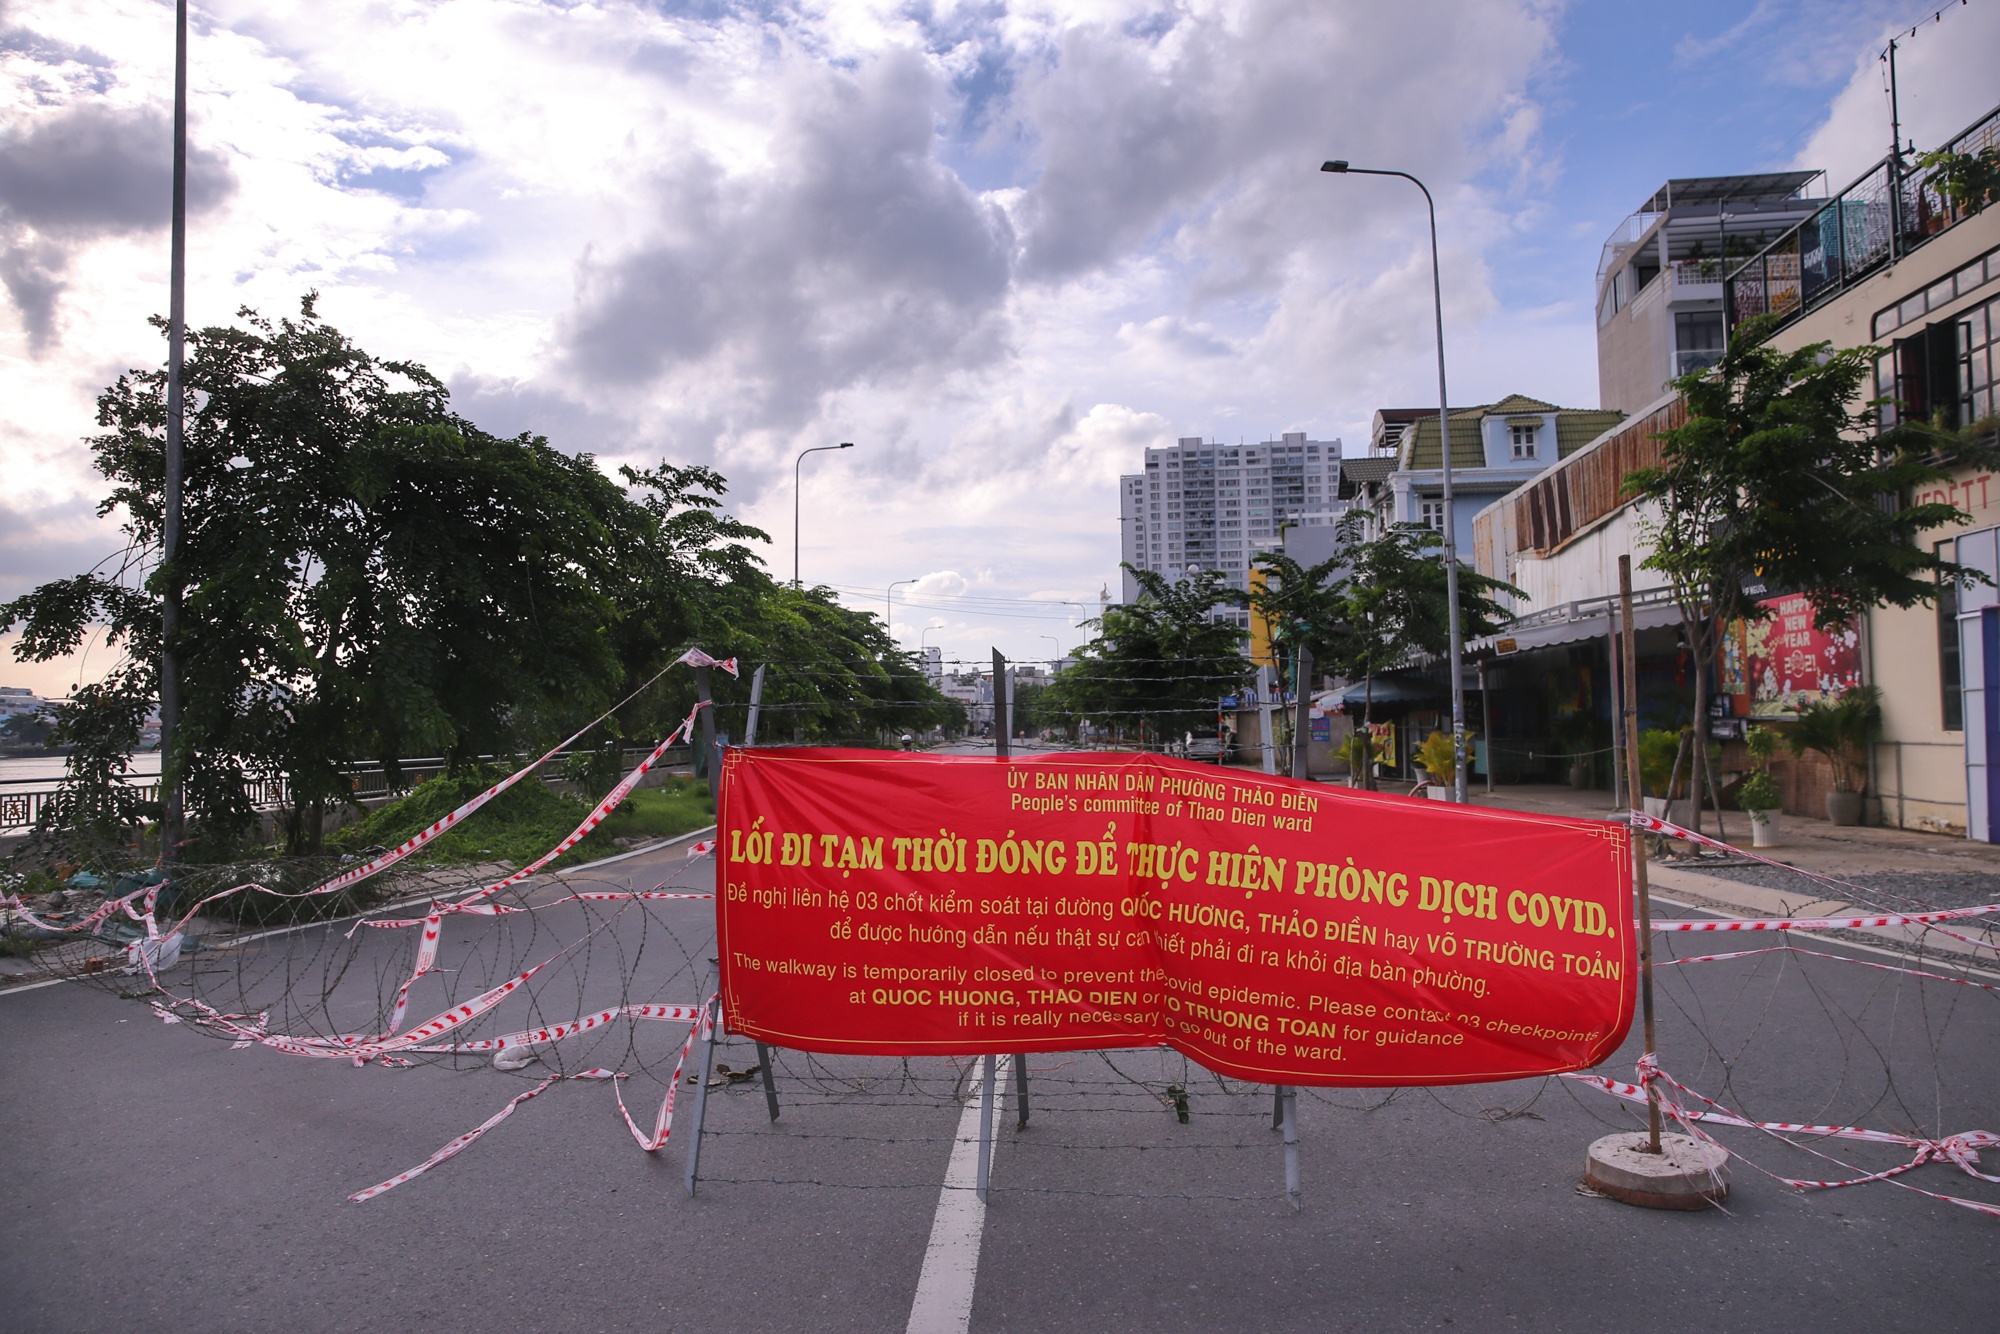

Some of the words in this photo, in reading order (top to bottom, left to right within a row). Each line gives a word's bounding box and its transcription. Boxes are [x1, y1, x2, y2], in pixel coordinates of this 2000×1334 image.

[1779, 598, 1810, 616] HAPPY
[1784, 614, 1807, 632] NEW
[1783, 631, 1811, 649] YEAR
[1007, 765, 1029, 789] ỦY
[1035, 772, 1069, 790] BAN
[1074, 770, 1119, 792] NHÂN
[1125, 770, 1155, 793] DÂN
[1159, 776, 1226, 802] PHƯỜNG
[1231, 785, 1275, 808] THẢO
[1280, 790, 1319, 814] ĐIỀN
[1011, 792, 1078, 816] People's
[1083, 795, 1160, 816] committee
[1165, 799, 1184, 818] of
[1187, 800, 1225, 822] Thao
[1230, 806, 1267, 828] Dien
[1272, 815, 1313, 833] ward
[729, 815, 775, 865] LỐI
[779, 832, 814, 868] ĐI
[819, 833, 885, 879] TẠM
[891, 827, 968, 873] THỜI
[975, 829, 1068, 876] ĐÓNG
[1075, 820, 1119, 876] ĐỂ
[1125, 839, 1200, 890] THỰC
[1205, 843, 1288, 900] HIỆN
[1292, 856, 1410, 909] PHÒNG
[1417, 875, 1499, 924] DỊCH
[1506, 889, 1617, 939] COVID.
[727, 881, 748, 903] Đề
[752, 886, 787, 910] nghị
[792, 887, 822, 908] liên
[828, 889, 850, 913] hệ
[855, 890, 879, 911] 03
[883, 890, 924, 913] chốt
[929, 888, 973, 914] kiểm
[979, 895, 1021, 915] soát
[1025, 896, 1049, 919] tại
[1054, 896, 1114, 922] đường
[1168, 902, 1251, 935] HƯƠNG,
[1257, 908, 1319, 939] THẢO
[1323, 915, 1377, 946] ĐIỀN
[1383, 927, 1420, 956] hay
[1426, 931, 1458, 957] VÕ
[1462, 938, 1555, 972] TRƯỜNG
[1561, 943, 1621, 982] TOẢN
[829, 915, 852, 941] để
[857, 921, 903, 946] được
[908, 923, 967, 949] hướng
[972, 923, 1008, 945] dẫn
[1014, 924, 1050, 947] nếu
[1055, 927, 1092, 950] thật
[1097, 930, 1121, 951] sự
[1153, 930, 1186, 955] hiết
[1190, 937, 1231, 961] phải
[1236, 943, 1255, 964] đi
[1260, 950, 1280, 968] ra
[1285, 948, 1327, 973] khỏi
[1333, 954, 1363, 980] địa
[1369, 958, 1407, 983] bàn
[1412, 966, 1491, 999] phường.
[733, 951, 761, 971] The
[765, 958, 837, 982] walkway
[843, 961, 858, 979] is
[862, 963, 968, 986] temporarily
[973, 965, 1035, 982] closed
[1039, 967, 1058, 981] to
[1063, 968, 1135, 985] prevent
[1139, 967, 1166, 983] the
[1207, 984, 1301, 1011] epidemic.
[1308, 994, 1377, 1018] Please
[1485, 1019, 1600, 1042] checkpoints
[848, 988, 867, 1005] at
[871, 987, 933, 1006] QUOC
[938, 989, 1021, 1009] HUONG,
[1026, 988, 1084, 1005] THAO
[1089, 990, 1138, 1006] DIEN
[1142, 992, 1161, 1005] or
[1183, 999, 1270, 1033] TRUONG
[1276, 1016, 1337, 1039] TOAN
[1342, 1024, 1370, 1042] for
[1375, 1028, 1465, 1047] guidance
[958, 1011, 969, 1027] if
[975, 1011, 986, 1027] it
[991, 1011, 1007, 1027] is
[1013, 1009, 1063, 1029] really
[1069, 1010, 1160, 1027] necessary
[1162, 1013, 1176, 1029] o
[1179, 1021, 1201, 1035] go
[1203, 1027, 1228, 1048] out
[1232, 1035, 1252, 1052] of
[1256, 1037, 1287, 1057] the
[1293, 1044, 1347, 1062] ward.
